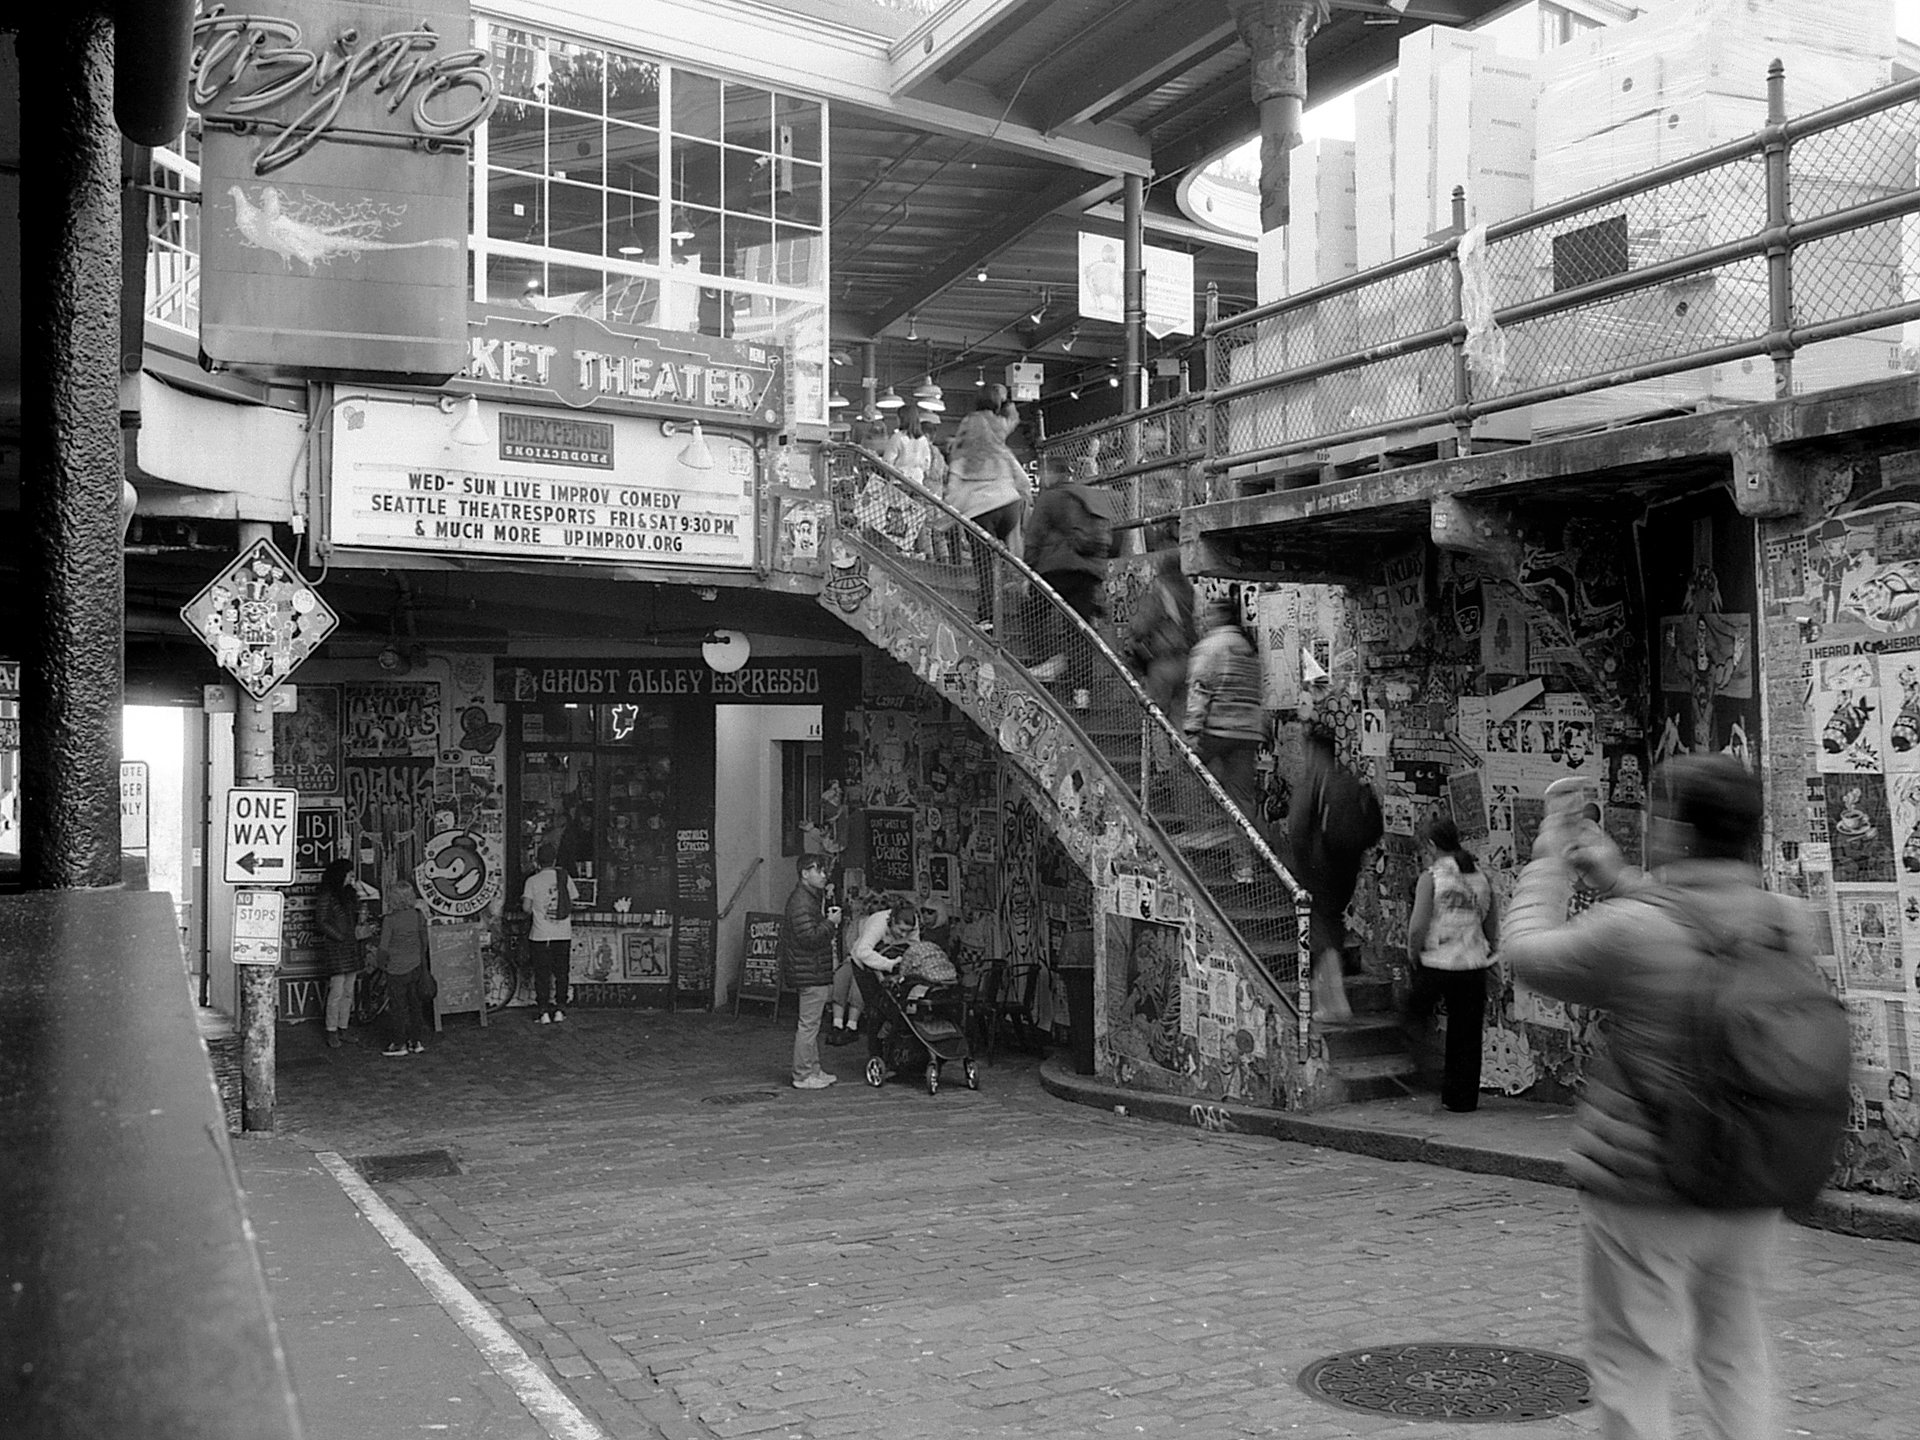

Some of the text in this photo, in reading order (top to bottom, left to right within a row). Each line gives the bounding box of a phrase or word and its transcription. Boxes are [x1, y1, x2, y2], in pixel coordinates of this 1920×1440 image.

[459, 337, 557, 386] KET
[573, 350, 756, 412] THEATER
[504, 415, 609, 449] UNEXPECTED
[504, 446, 609, 466] PRODUCTIONS
[463, 477, 496, 496] SUN
[504, 481, 541, 500] LIVE
[551, 484, 610, 505] IMPROV
[620, 490, 681, 511] COMEDY
[372, 494, 447, 516] SEATTLE
[459, 500, 596, 526] THEATRESPORTS
[681, 516, 711, 533] 9:30
[714, 519, 735, 536] PM
[415, 519, 683, 552] & MUCH MORE UPIMPROV.ORG
[1814, 644, 1850, 659] HEARD
[541, 668, 820, 698] GHOST ALLEY ESPRESSO
[1557, 708, 1593, 717] MISSING
[121, 766, 143, 777] UTE
[273, 763, 336, 776] FREYA
[121, 783, 143, 797] GER
[120, 802, 142, 817] NLY
[236, 797, 287, 819] ONE
[234, 824, 288, 846] WAY
[875, 846, 909, 862] DRINKS
[237, 894, 252, 906] NO
[240, 908, 277, 922] STOPS
